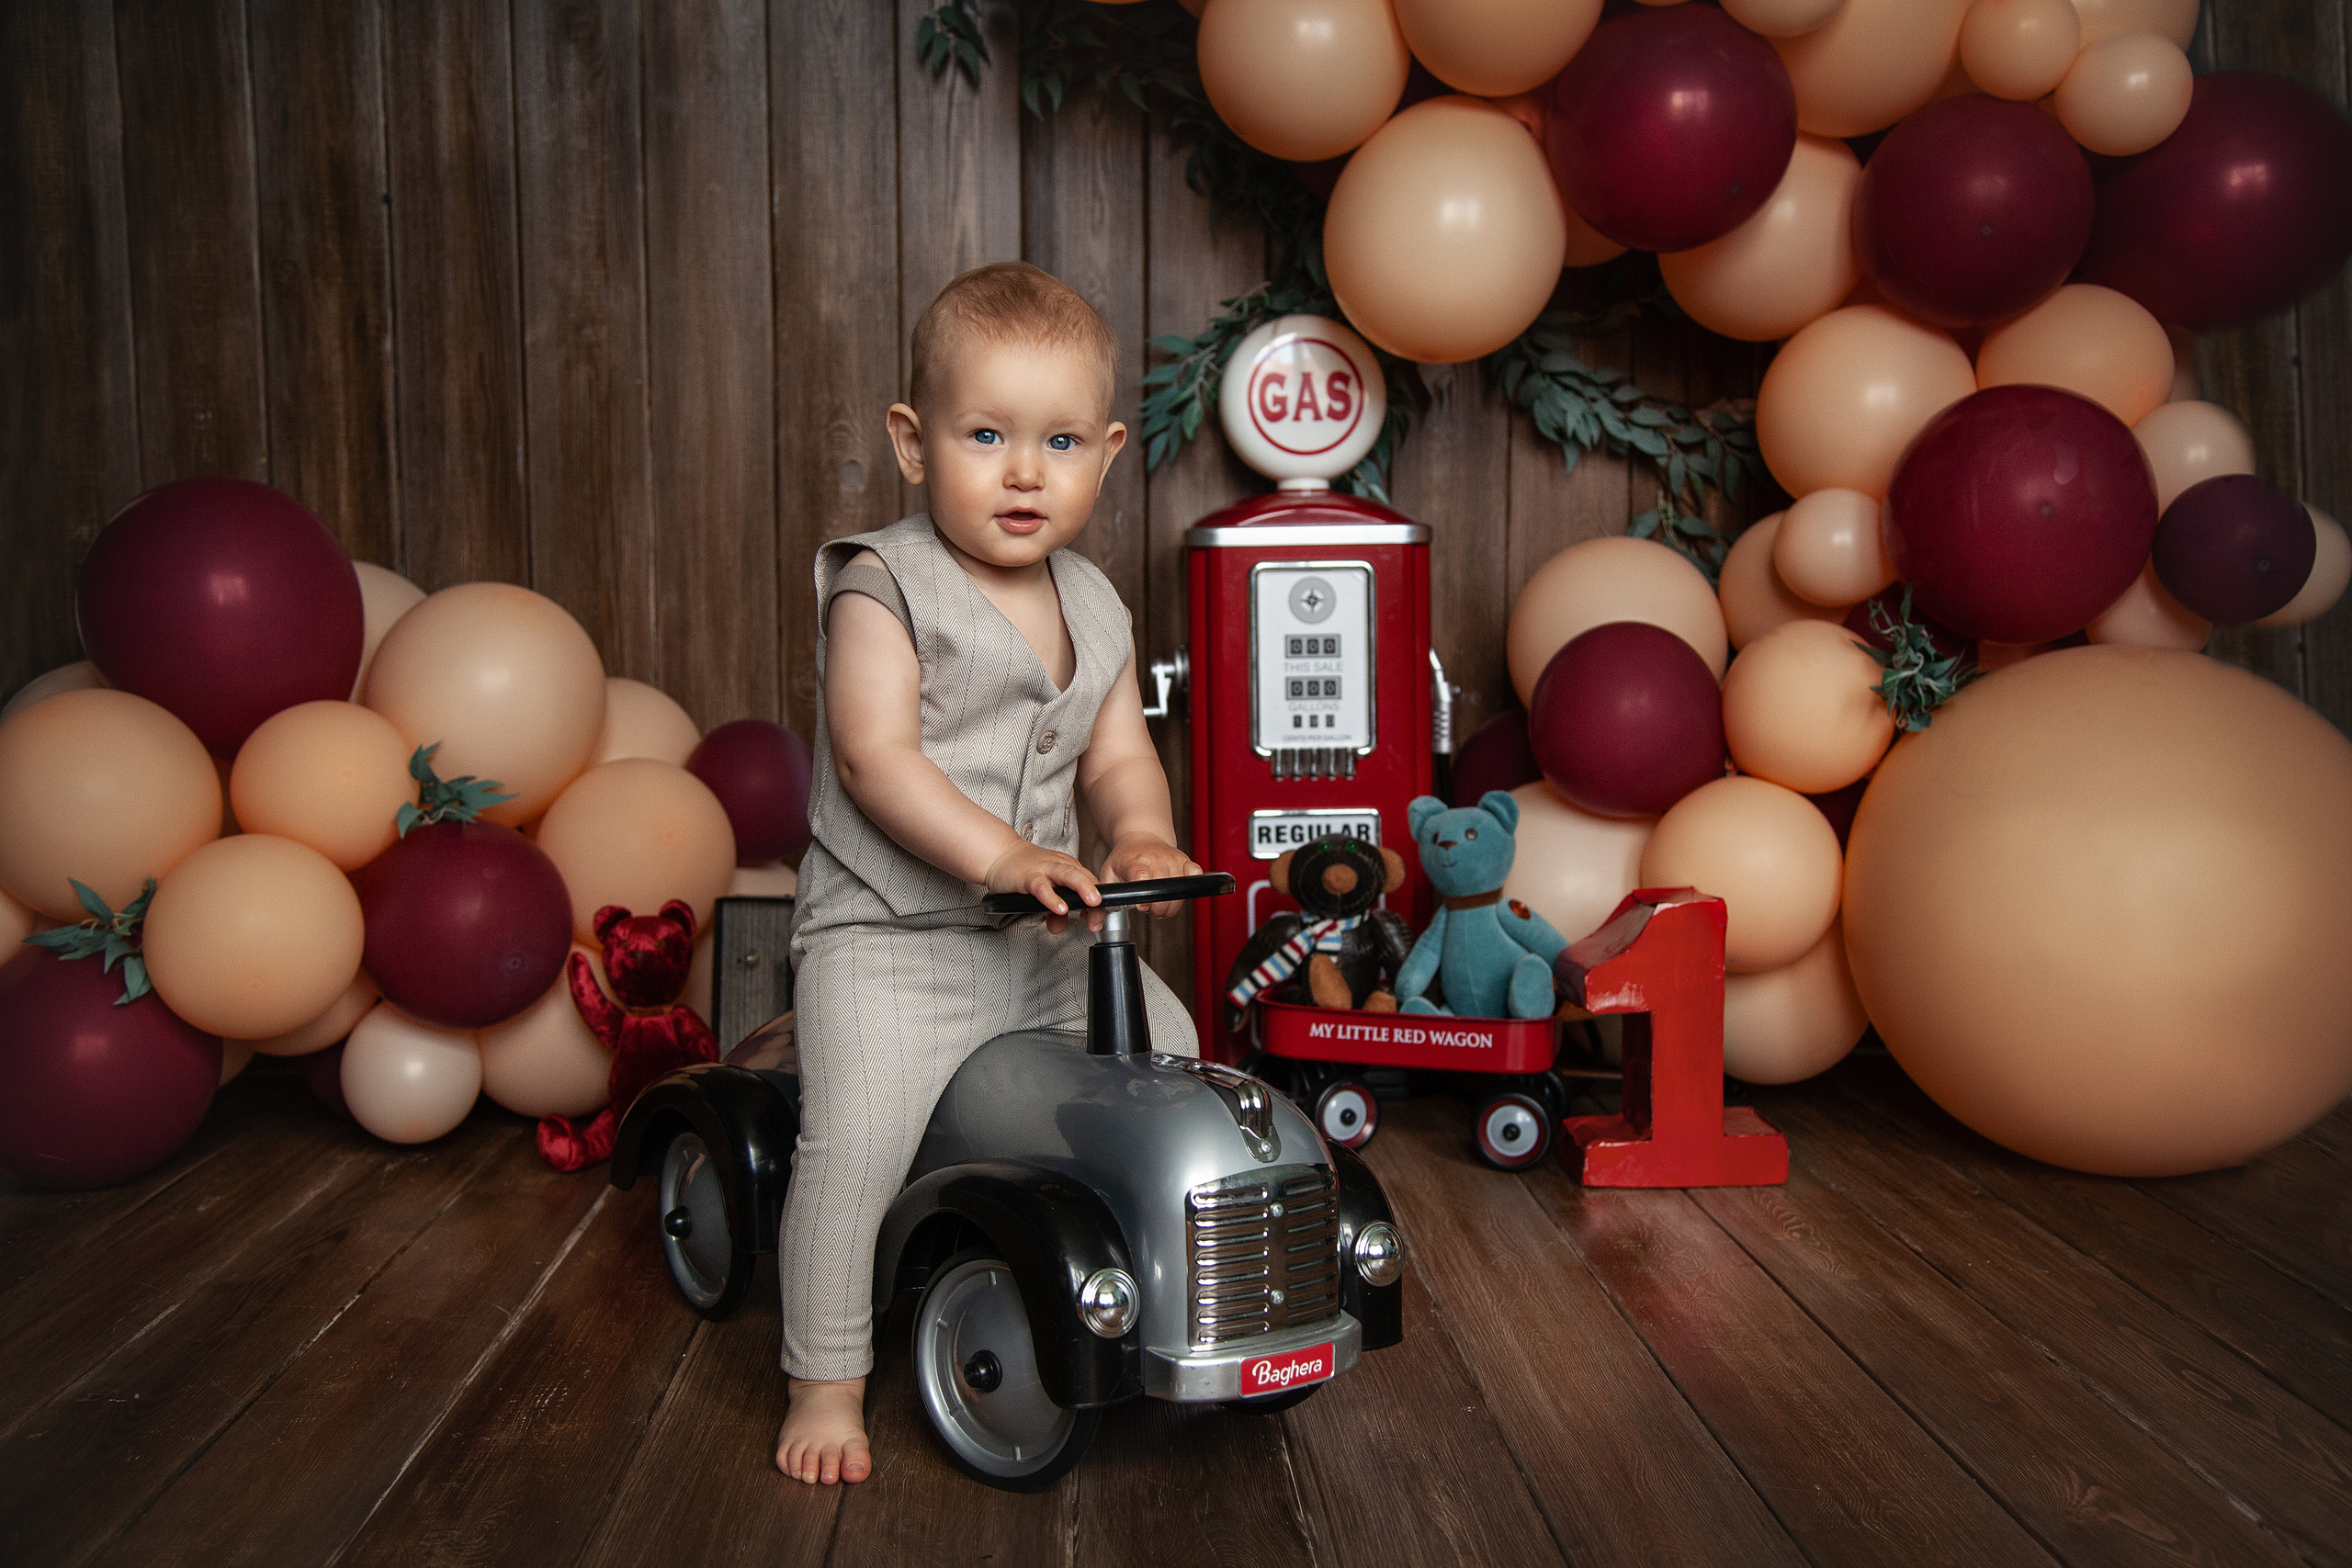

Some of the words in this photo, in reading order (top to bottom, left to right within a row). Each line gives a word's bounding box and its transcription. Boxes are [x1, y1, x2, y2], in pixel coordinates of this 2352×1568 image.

[1259, 370, 1352, 423] GAS
[1284, 661, 1311, 672] THIS
[1314, 661, 1343, 672] SALE
[1288, 701, 1340, 712] GALLONS
[1309, 1022, 1334, 1039] MY
[1337, 1024, 1389, 1043] LITTLE
[1393, 1028, 1426, 1044] RED
[1429, 1030, 1493, 1049] WAGON
[1557, 887, 1789, 1188] 1
[1251, 1358, 1323, 1386] Baghera
